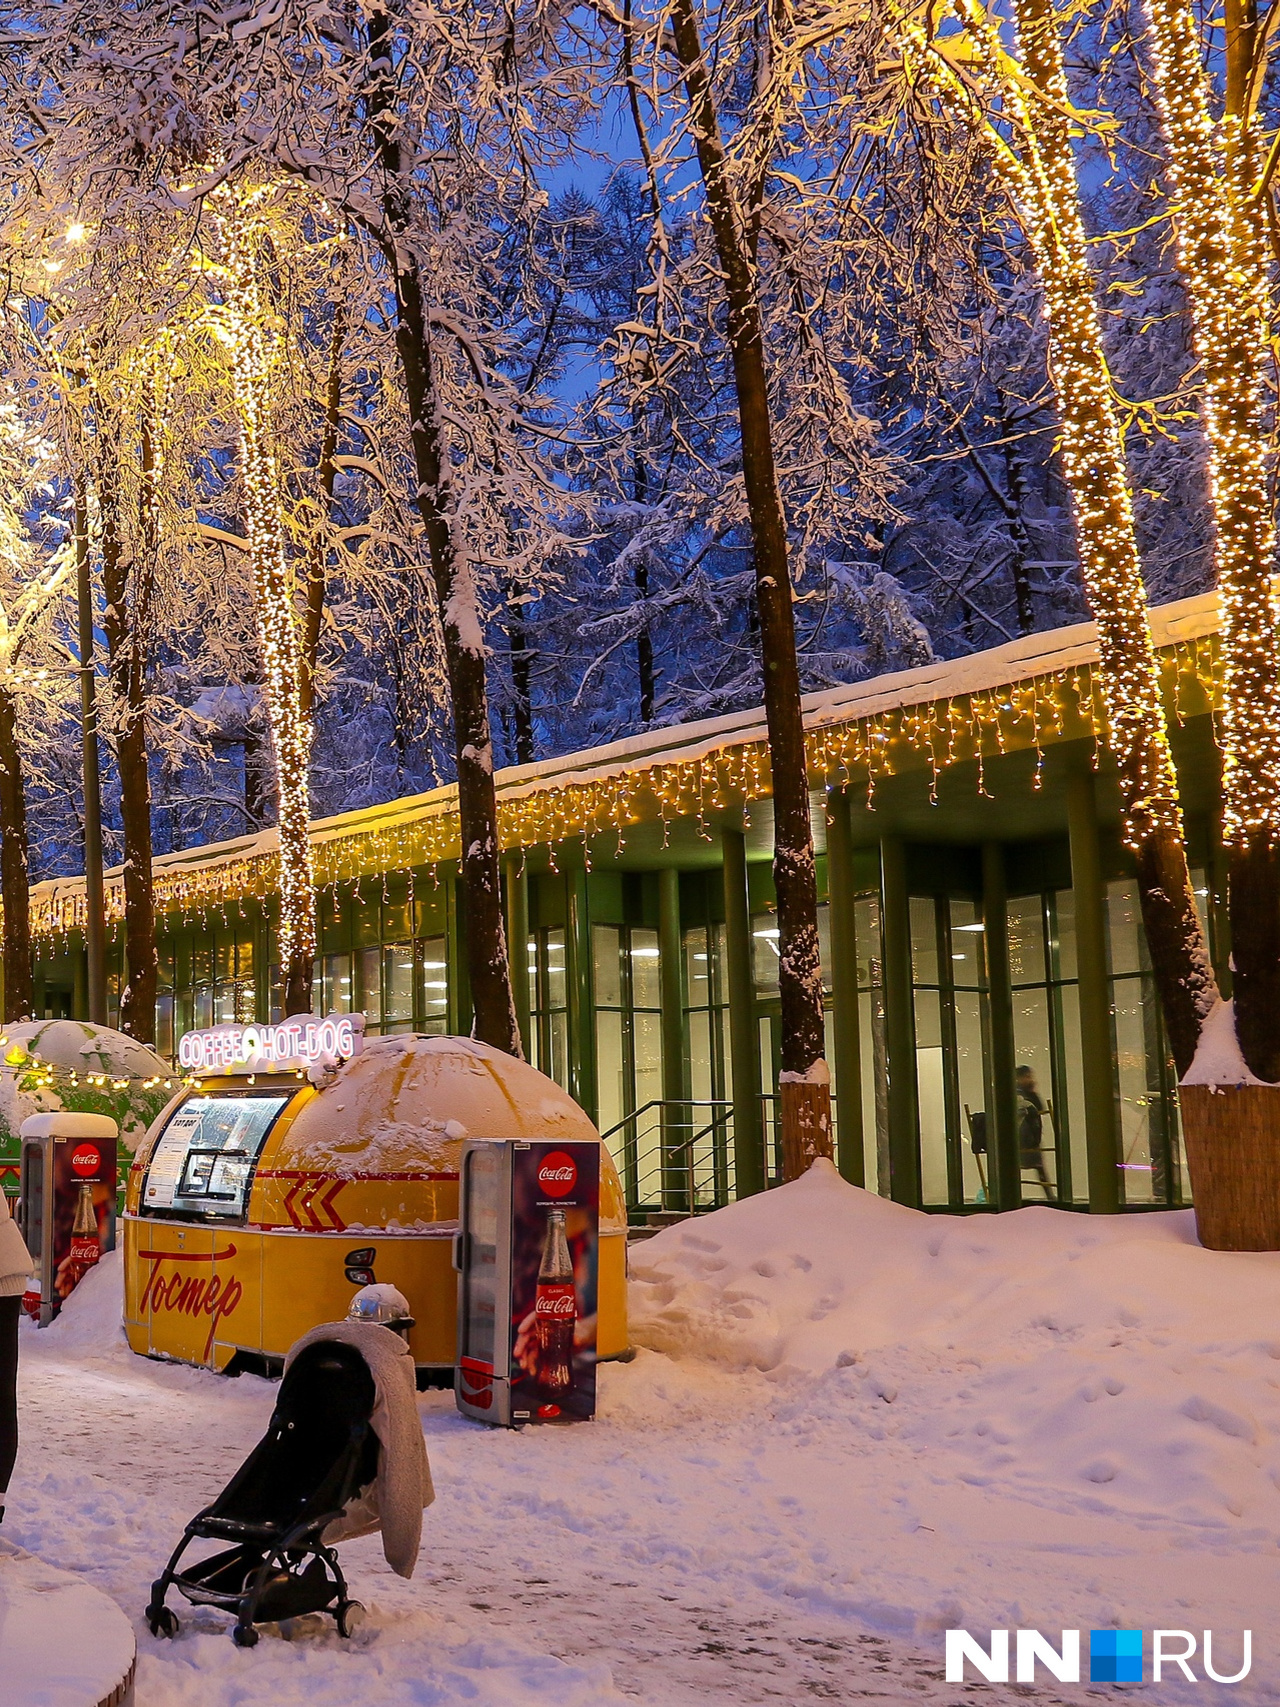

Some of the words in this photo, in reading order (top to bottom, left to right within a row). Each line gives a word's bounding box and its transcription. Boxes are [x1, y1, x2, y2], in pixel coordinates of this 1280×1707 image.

[179, 1029, 242, 1068] COFFEE
[260, 1019, 353, 1061] HOT-DOG
[72, 1154, 99, 1165] Coca-Cola
[538, 1166, 575, 1181] Coca-Cola
[70, 1245, 99, 1258] Coca-Cola
[138, 1242, 242, 1363] Тостер
[535, 1295, 575, 1314] Coca-Cola
